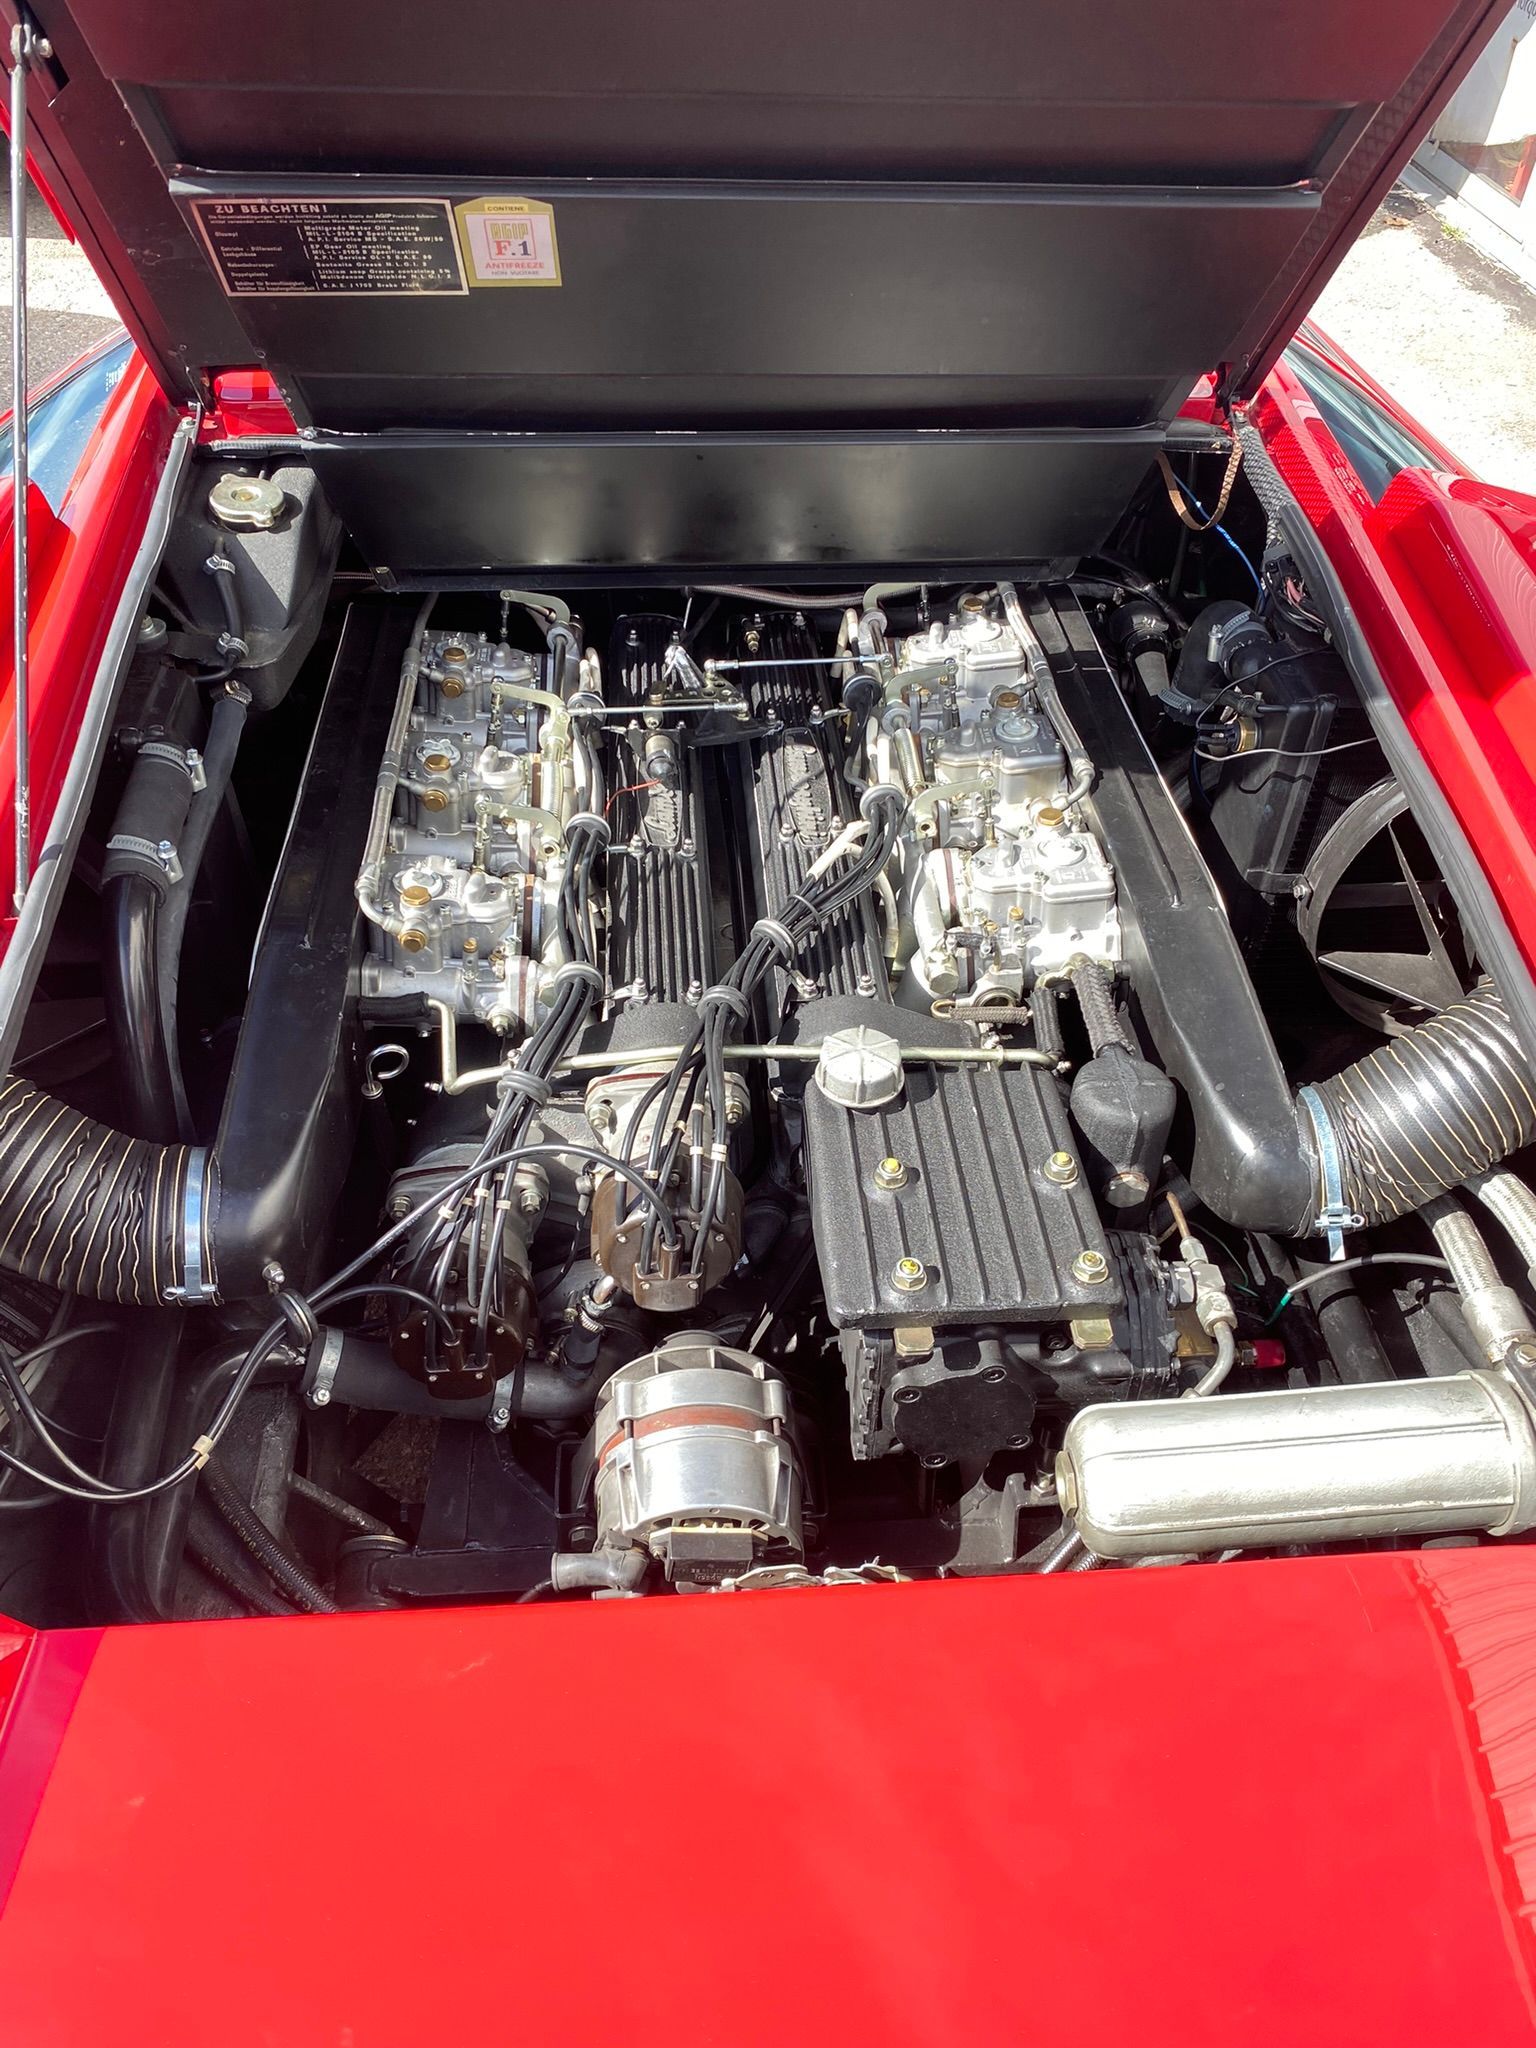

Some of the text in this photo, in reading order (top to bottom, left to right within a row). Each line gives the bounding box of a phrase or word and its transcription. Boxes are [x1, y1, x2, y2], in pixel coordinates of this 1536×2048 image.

[214, 204, 327, 213] ZU BEACHTEN!
[494, 240, 532, 256] F.1
